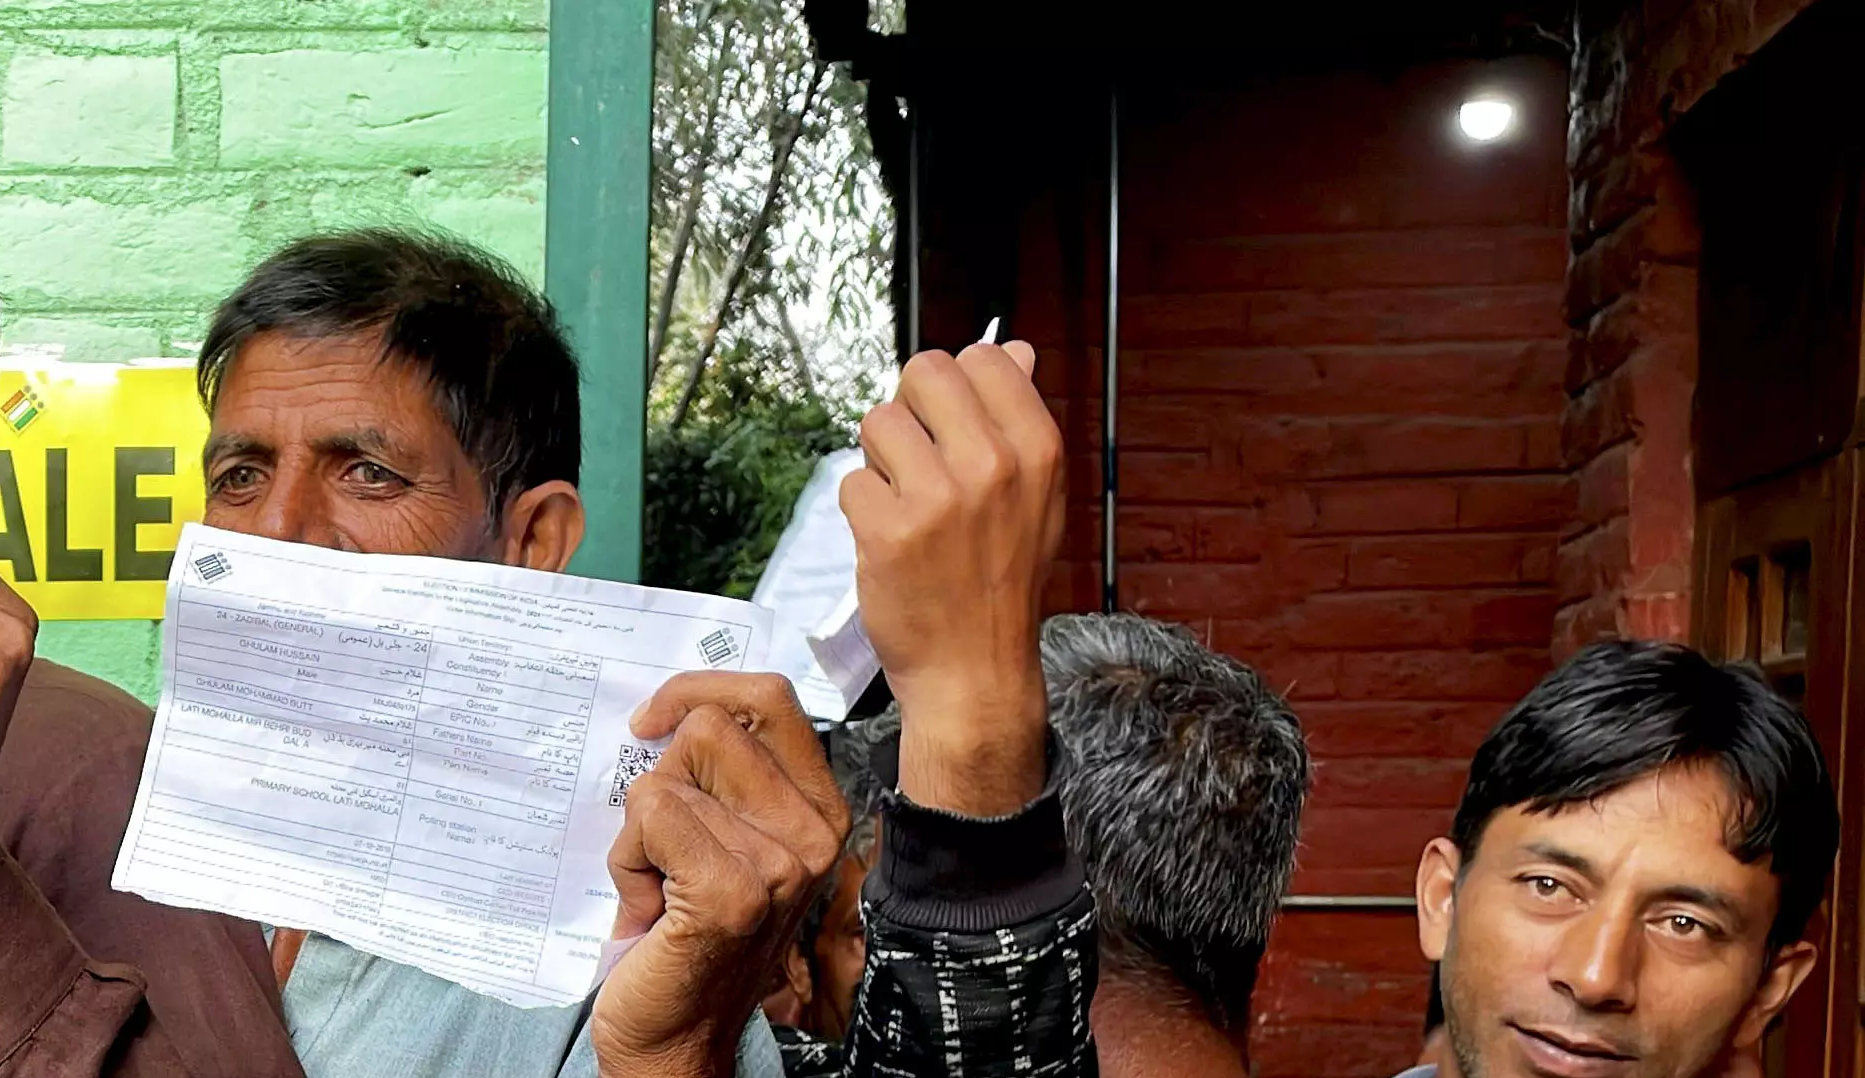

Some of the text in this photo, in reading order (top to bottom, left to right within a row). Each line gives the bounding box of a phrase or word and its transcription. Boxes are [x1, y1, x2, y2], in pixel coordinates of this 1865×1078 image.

[468, 652, 510, 668] Assembly
[476, 682, 503, 696] Name
[466, 699, 499, 713] Gender
